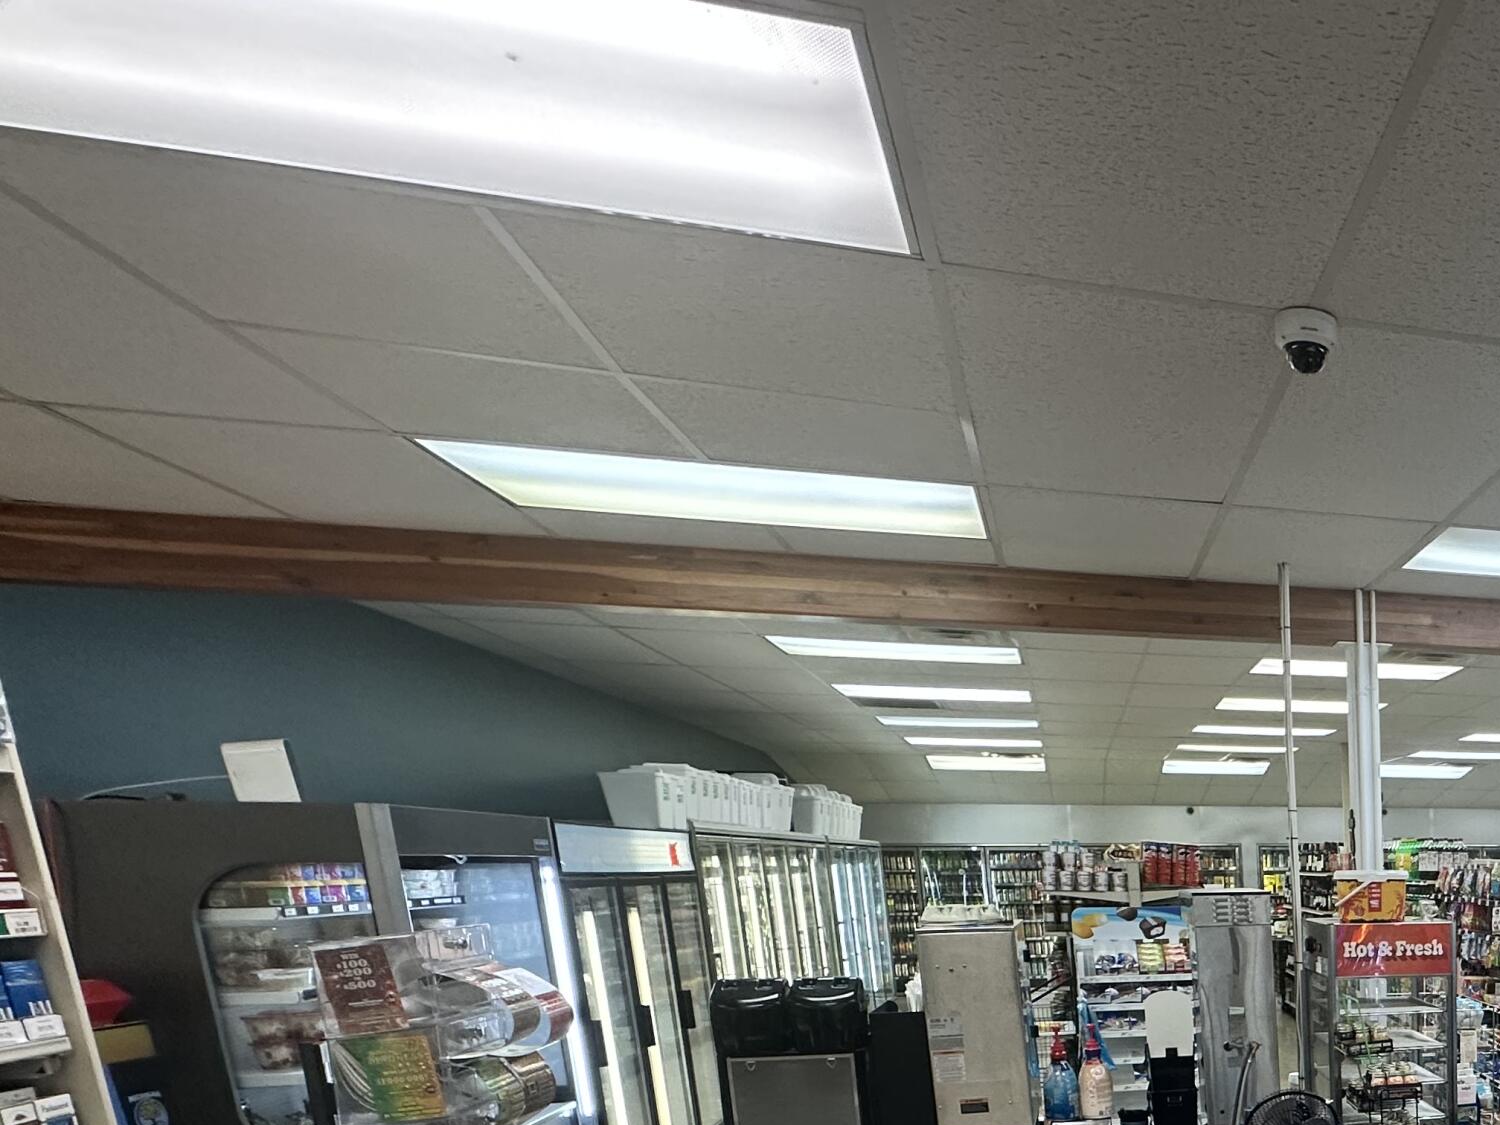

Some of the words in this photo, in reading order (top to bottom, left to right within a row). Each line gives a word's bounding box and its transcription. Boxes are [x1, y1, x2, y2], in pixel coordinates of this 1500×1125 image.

[1343, 941, 1375, 958] Hot
[1377, 940, 1393, 957] &
[1395, 938, 1444, 957] Fresh
